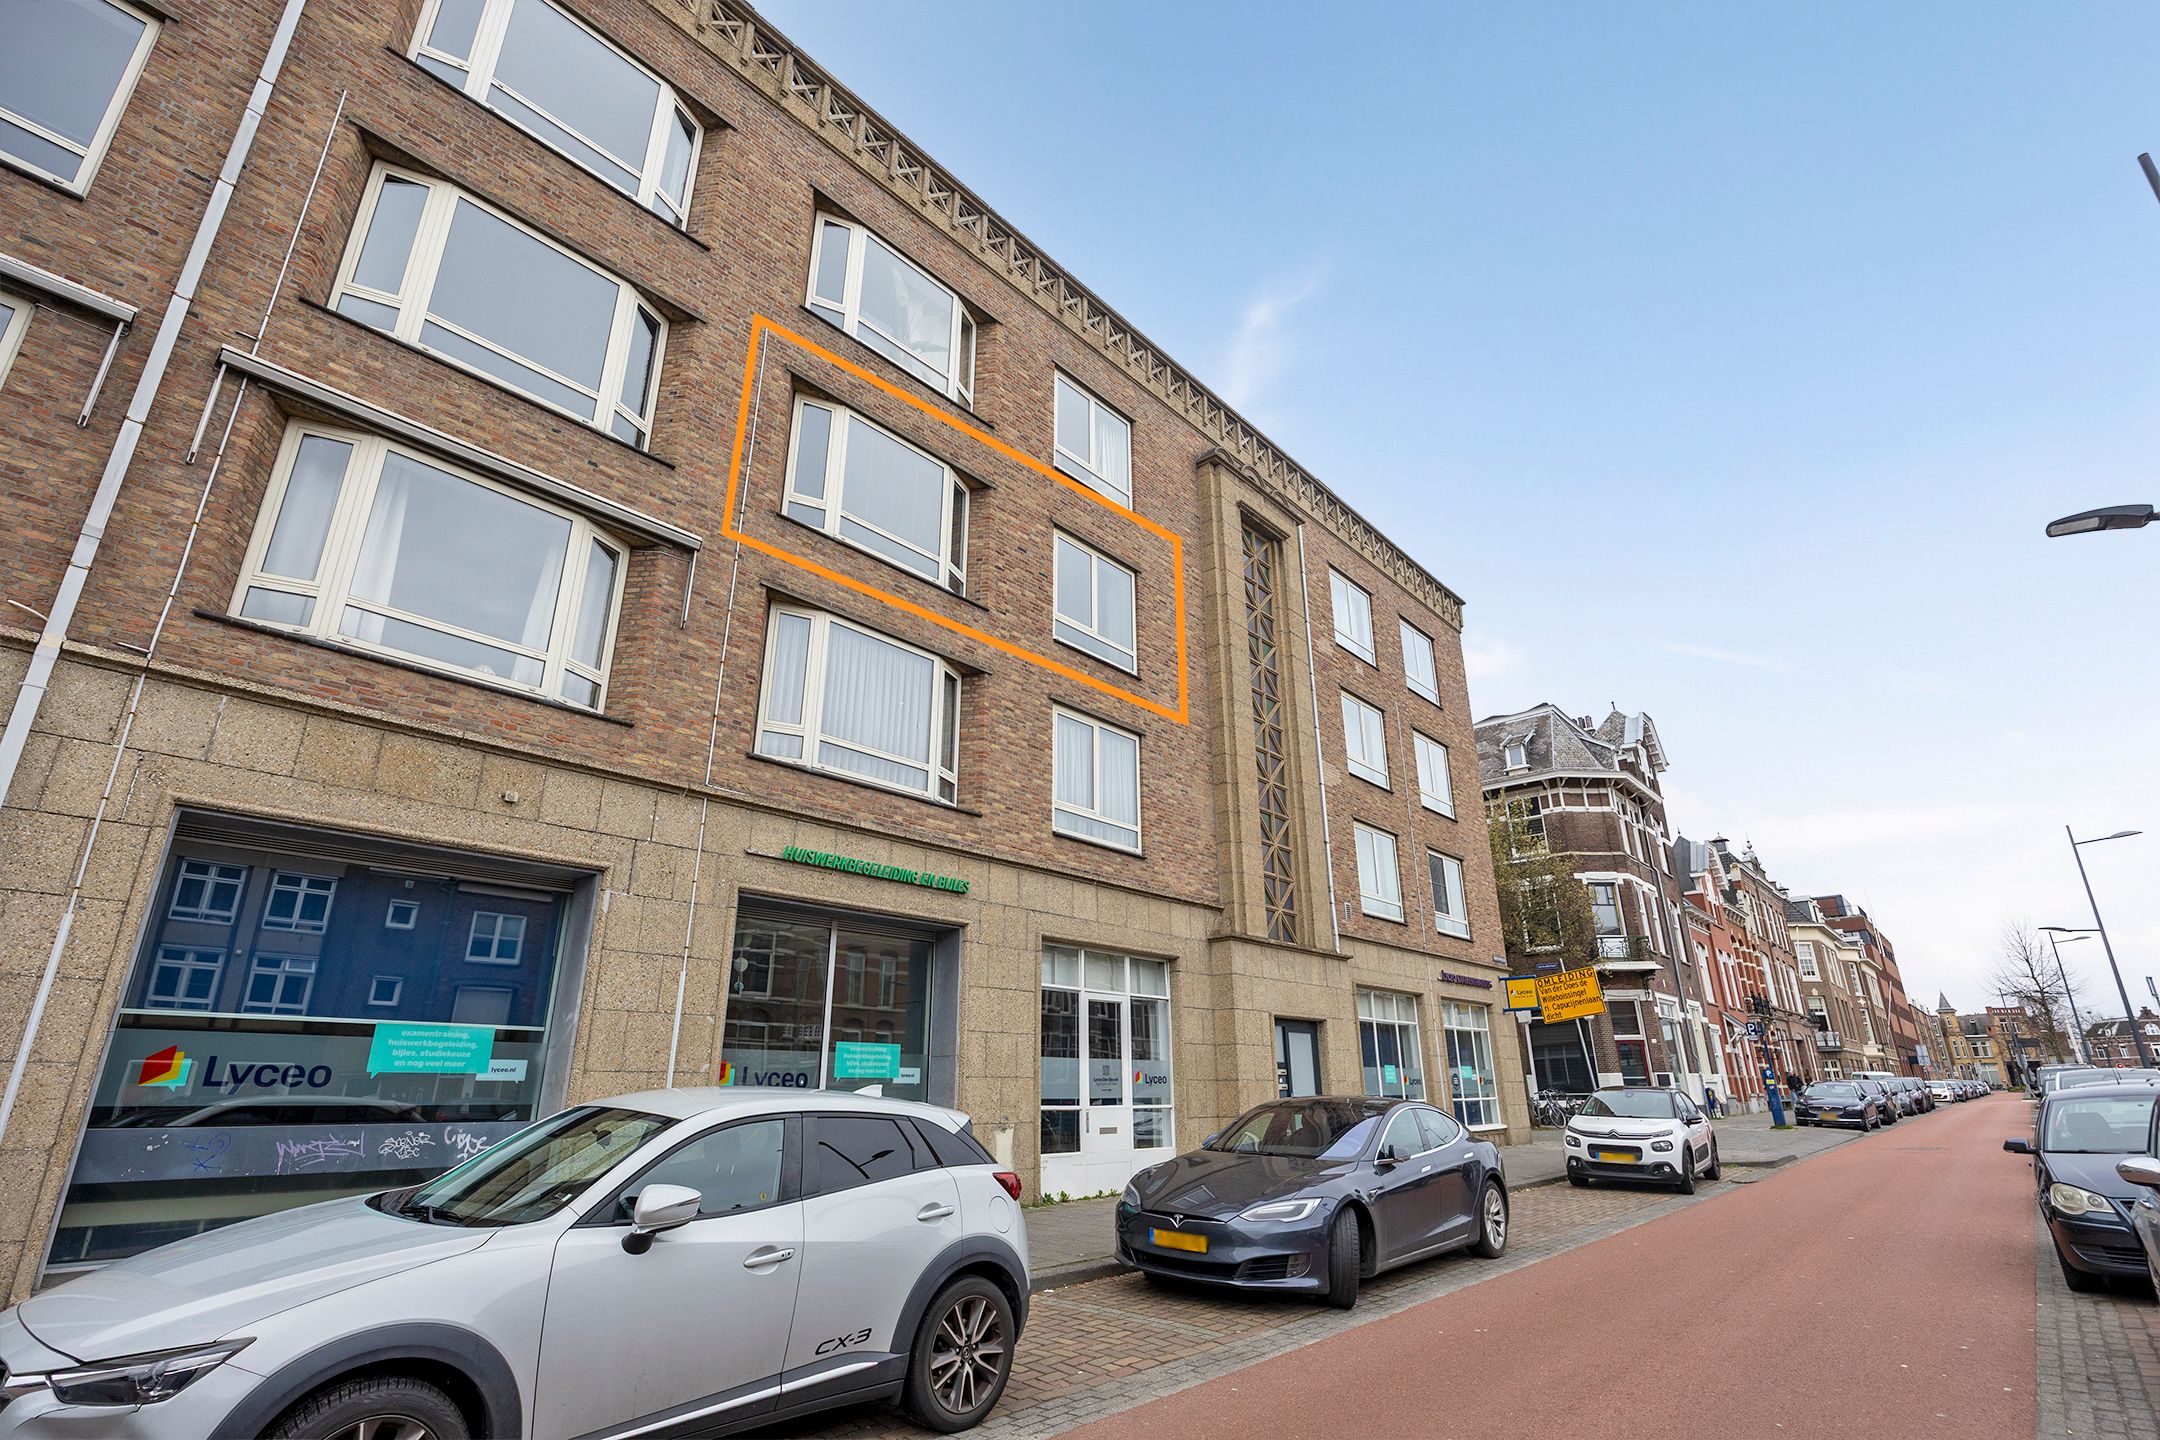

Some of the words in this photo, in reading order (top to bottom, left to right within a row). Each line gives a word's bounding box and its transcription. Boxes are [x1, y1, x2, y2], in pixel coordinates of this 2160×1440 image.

[783, 845, 919, 884] HUISWERKBEGELEIDING
[920, 872, 936, 887] EN
[937, 876, 970, 894] BIJLES
[1537, 968, 1594, 987] OMLEIDING
[1540, 985, 1553, 995] Van
[1553, 983, 1563, 992] der
[1564, 980, 1579, 990] Does
[1546, 1011, 1563, 1021] dicht
[1747, 1023, 1755, 1034] P
[420, 1049, 472, 1058] studiekeuze
[407, 1060, 424, 1068] nog
[426, 1059, 443, 1067] veel
[490, 1066, 516, 1074] lyceo.nl
[202, 1055, 332, 1096] Lyceo
[742, 1066, 809, 1088] Lyceo
[1145, 1073, 1168, 1087] Lyceo
[815, 1327, 873, 1356] CX-3
